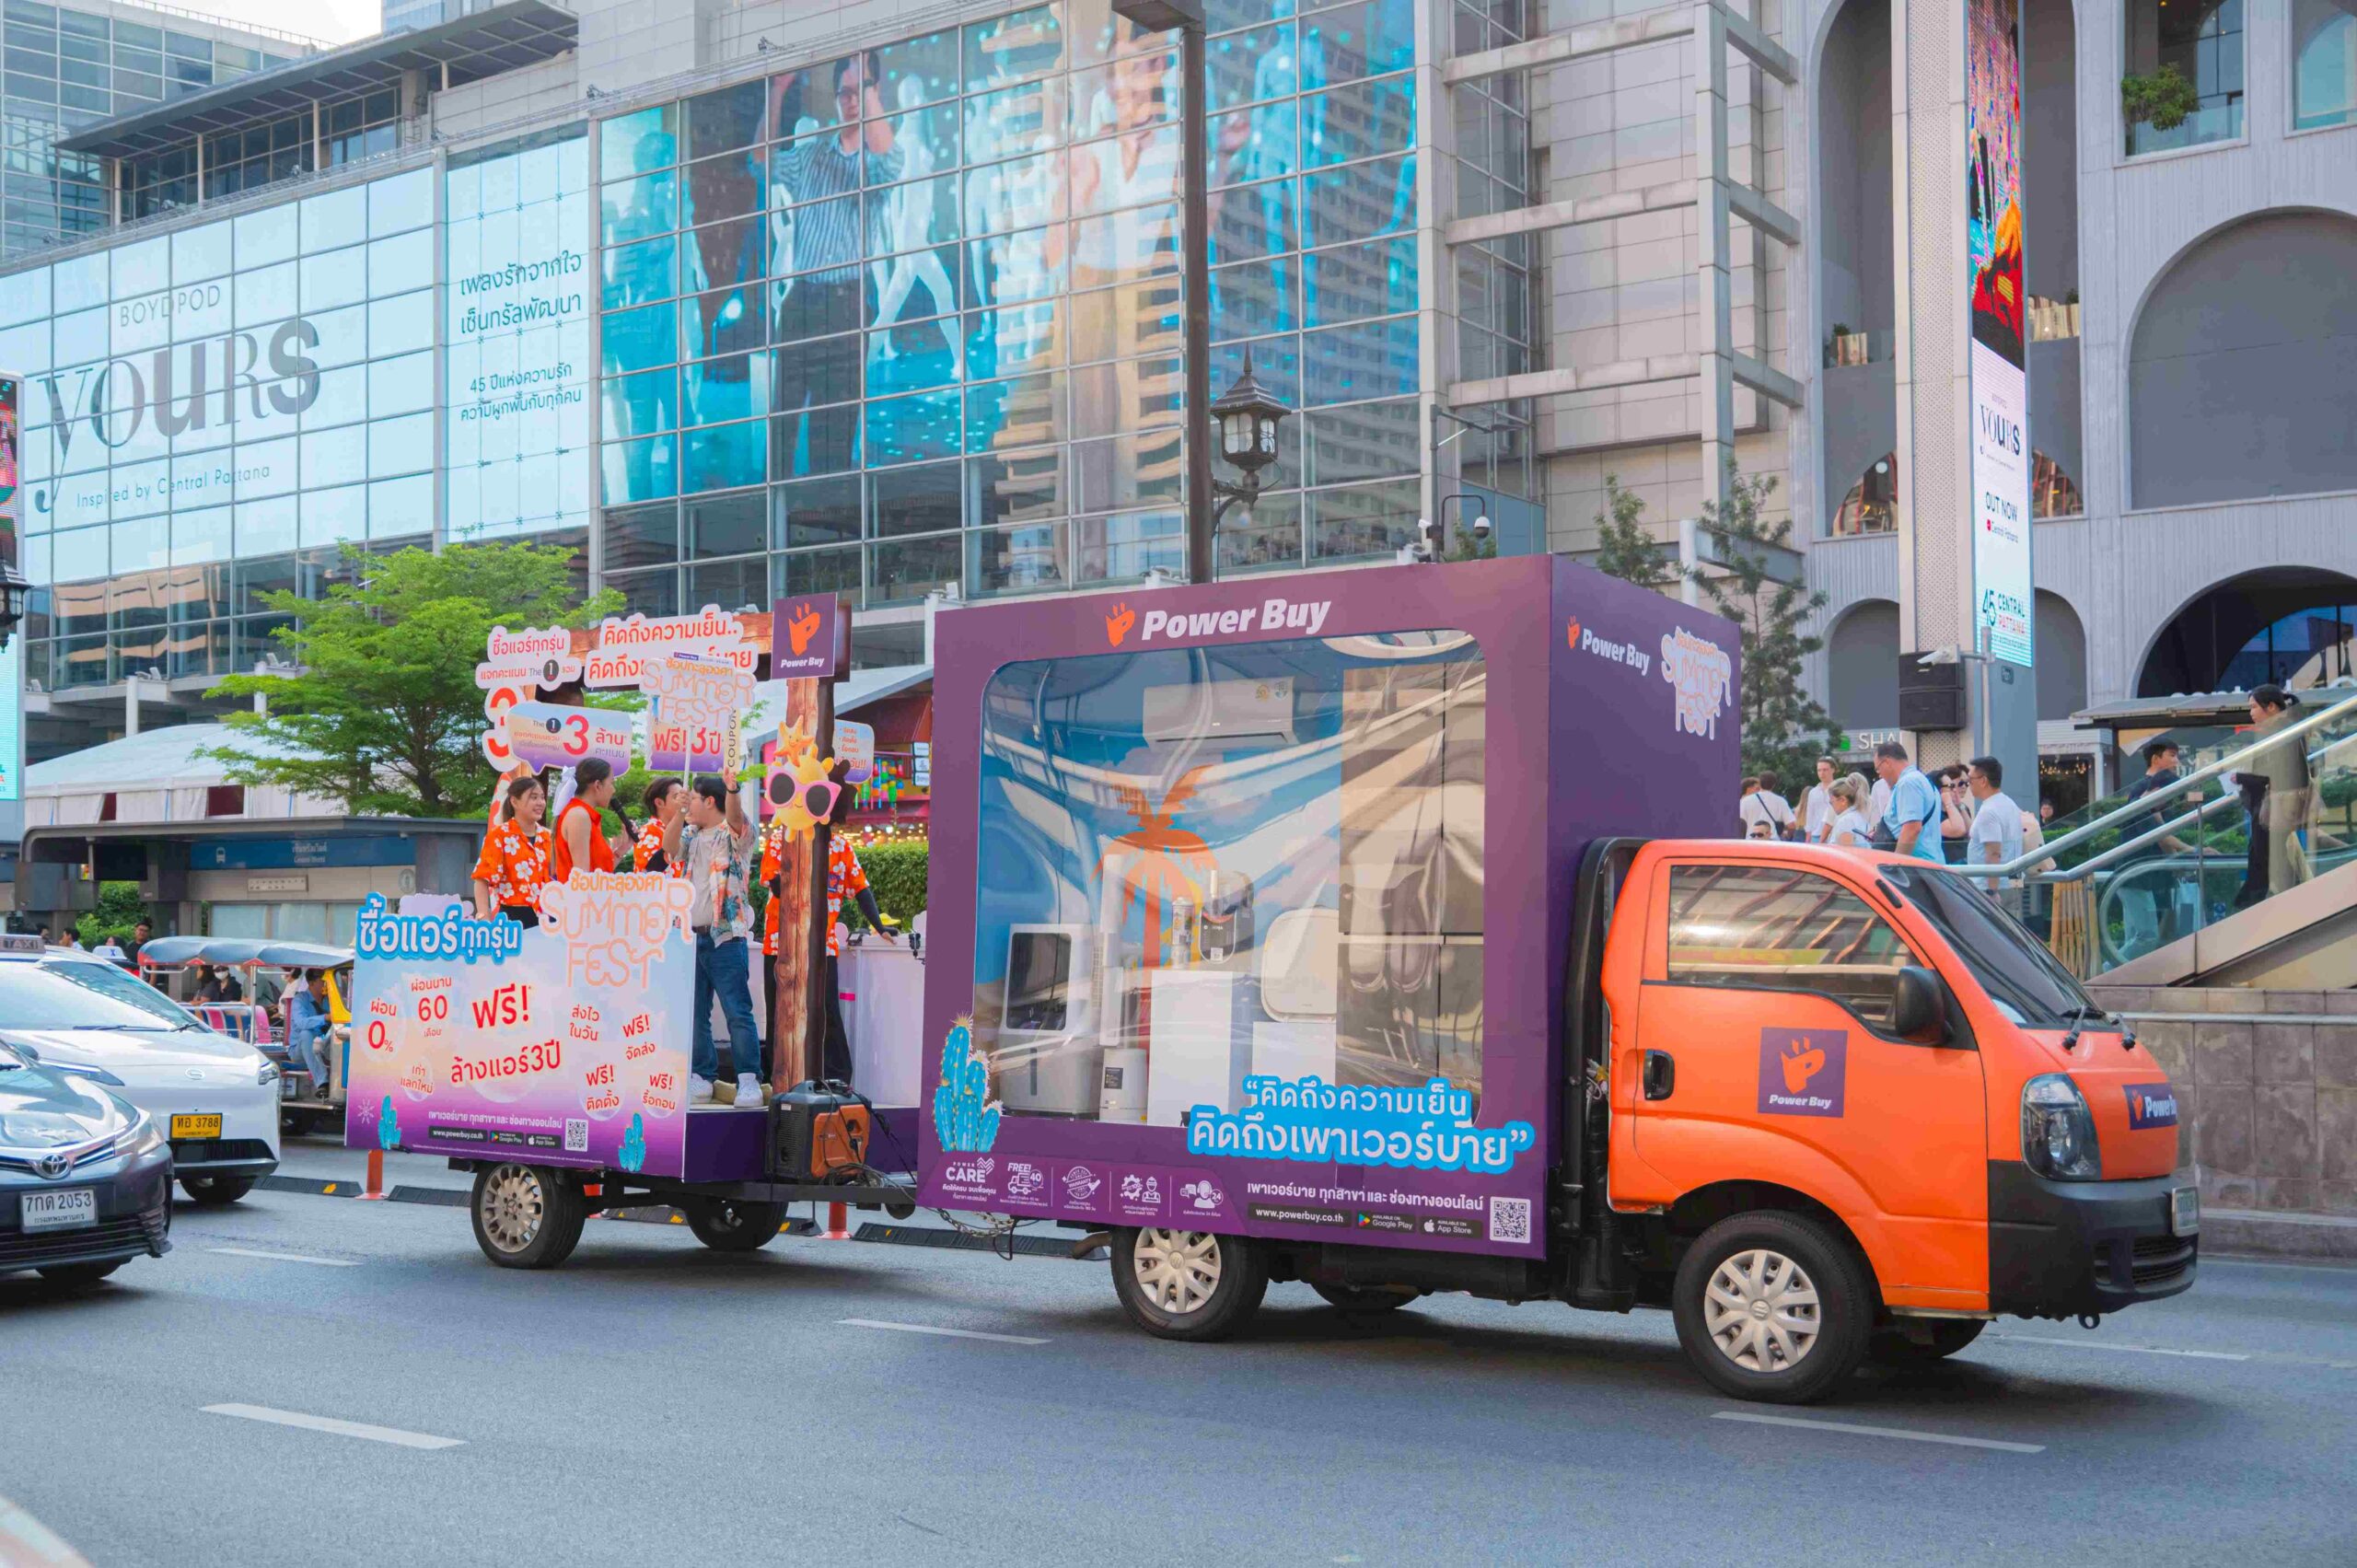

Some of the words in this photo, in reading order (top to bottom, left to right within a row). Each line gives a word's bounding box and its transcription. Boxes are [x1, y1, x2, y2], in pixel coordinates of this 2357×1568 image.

[460, 250, 582, 296] เพลงรักจากใจ
[460, 294, 581, 334] เซ็นทรัลพัฒนา
[470, 377, 486, 392] 45
[76, 487, 129, 509] Inspired
[135, 482, 151, 499] by
[157, 472, 208, 494] Central
[1986, 492, 2000, 514] OUT
[2002, 499, 2018, 522] NOW
[1998, 594, 2026, 617] CENTRAL
[1141, 608, 1257, 641] Power
[1260, 598, 1332, 634] Buy
[781, 658, 807, 668] Power
[807, 656, 825, 668] Buy
[1582, 628, 1626, 663] Power
[1626, 643, 1651, 677] Buy
[529, 668, 542, 677] The
[563, 714, 589, 756] 3
[596, 727, 624, 745] ล้าน
[726, 707, 737, 768] COUPON
[5, 939, 37, 949] TAXI
[412, 977, 452, 993] ผ่อนนาน
[371, 997, 397, 1016] ผ่อน
[418, 994, 448, 1022] 60
[472, 982, 529, 1029] ฟรี!
[572, 1004, 600, 1022] ส่งไว
[569, 1022, 598, 1041] ในวัน
[622, 1014, 650, 1038] ฟรี!
[625, 1042, 656, 1061] จัดส่ง
[586, 1063, 615, 1086] ฟรี!
[649, 1074, 674, 1091] ฟรี!
[586, 1089, 620, 1110] ติดตั้ง
[1769, 1095, 1808, 1105] Power
[1808, 1096, 1832, 1109] Buy
[2144, 1096, 2169, 1118] Power
[195, 1117, 219, 1128] 3788
[433, 1130, 484, 1141] www.powerbuy.co.th
[946, 1167, 986, 1183] CARE
[1007, 1163, 1032, 1173] FREE!
[57, 1192, 92, 1210] 2053
[1211, 1192, 1222, 1201] 24
[1248, 1182, 1317, 1198] เพาเวอร์บาย
[1319, 1186, 1365, 1202] ทุกสาขา
[1367, 1190, 1387, 1203] และ
[1389, 1189, 1483, 1211] ช่องทางออนไลน์
[1256, 1208, 1343, 1223] www.powerbuy.co.th
[1372, 1219, 1397, 1229] Google
[1398, 1221, 1413, 1231] Play
[1437, 1225, 1452, 1235] App
[1453, 1226, 1472, 1235] Store
